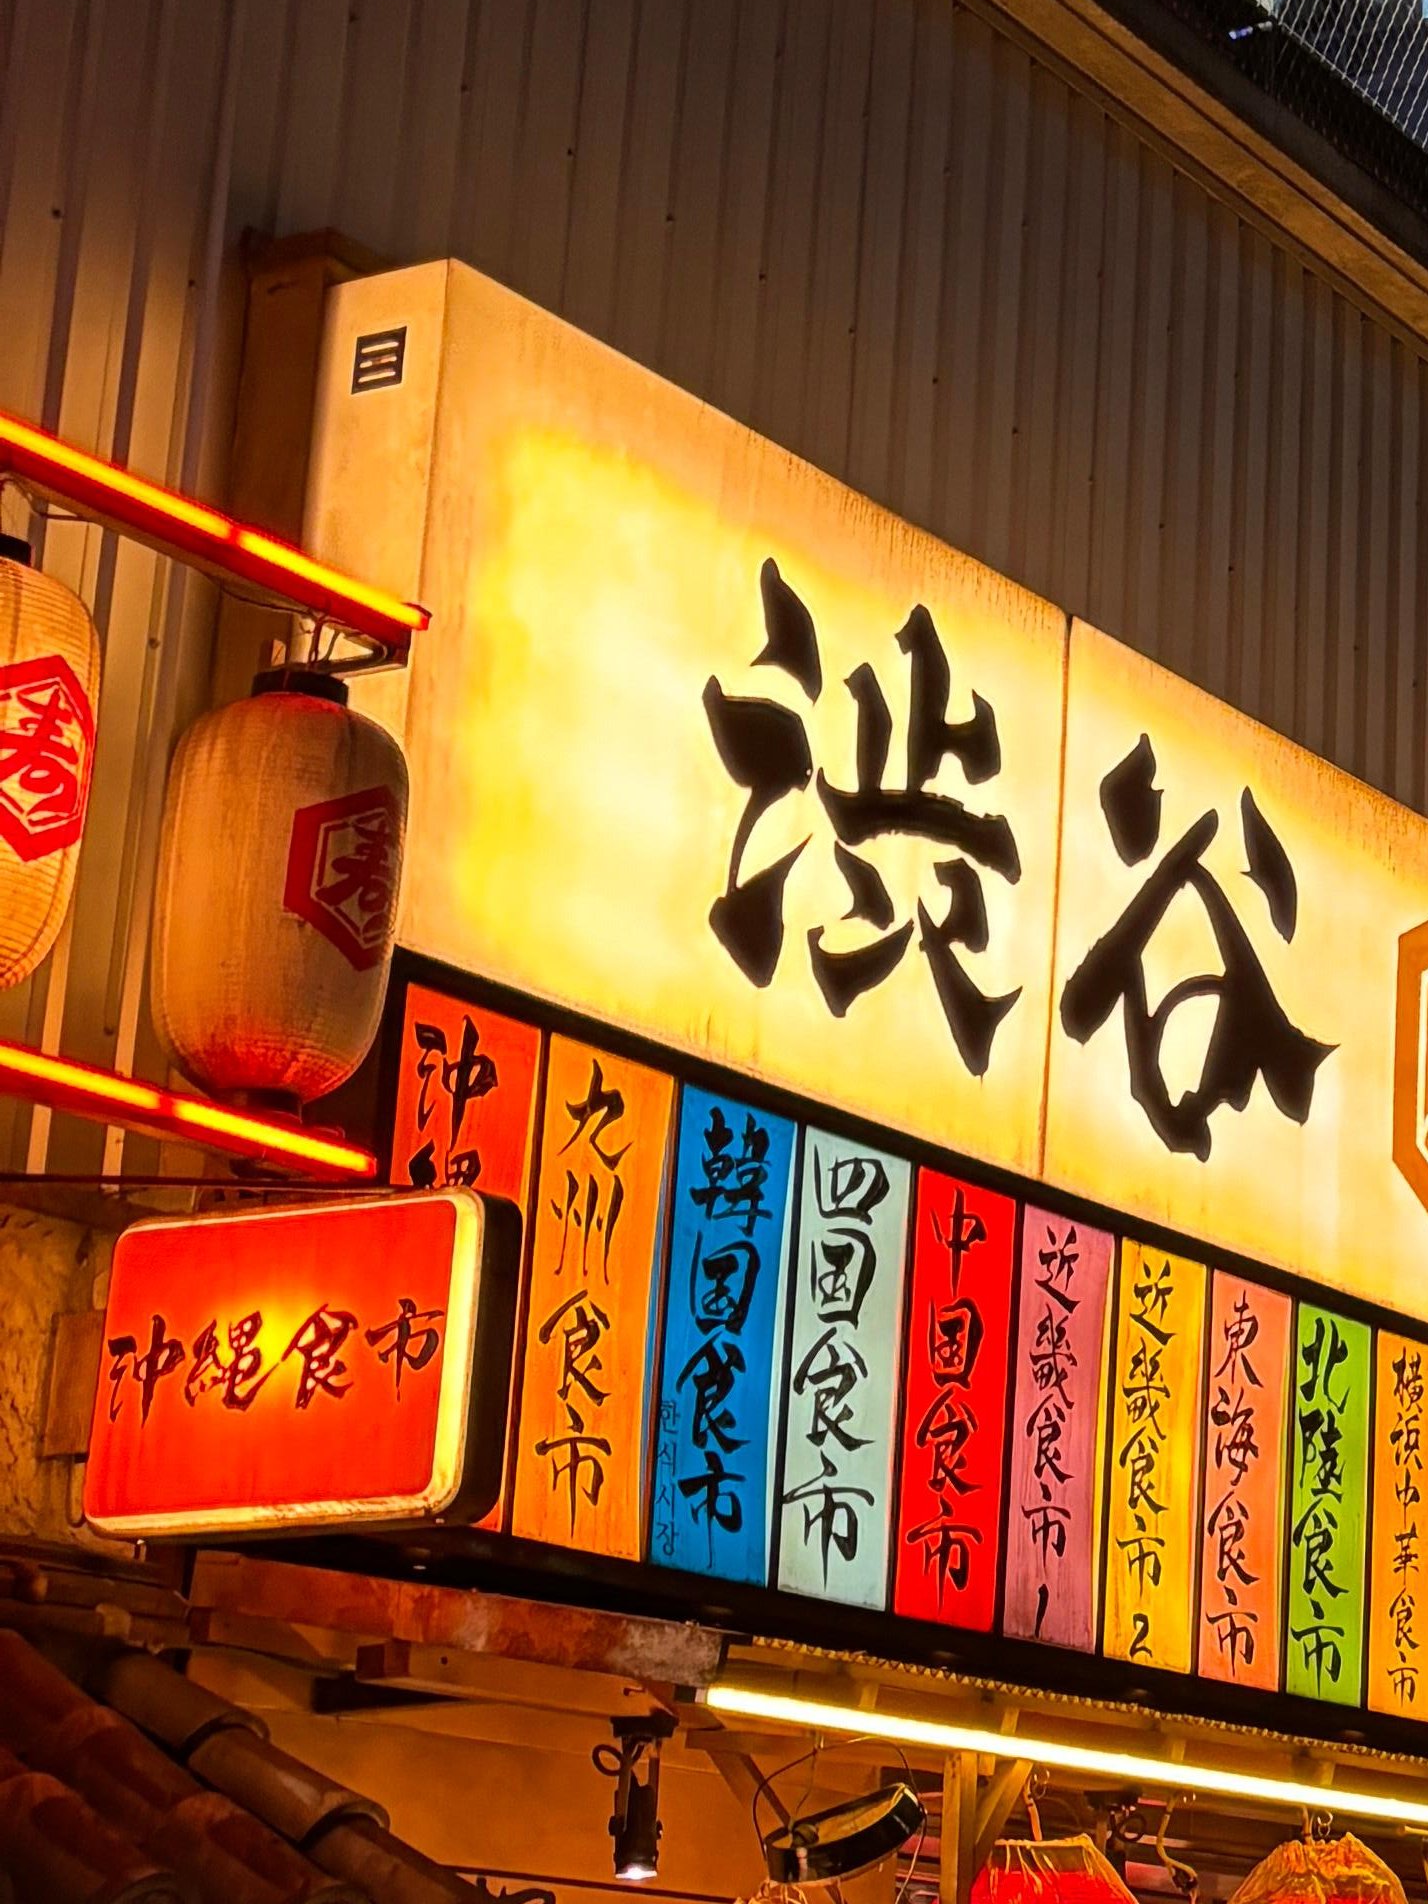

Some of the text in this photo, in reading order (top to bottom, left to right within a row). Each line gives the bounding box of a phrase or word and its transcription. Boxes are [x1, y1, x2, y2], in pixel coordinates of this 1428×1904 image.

[700, 557, 1340, 1163] 渋谷
[107, 1297, 445, 1430] 沖縄食市
[535, 1058, 634, 1538] 九州食市
[655, 1399, 681, 1557] 한식시장
[676, 1106, 773, 1568] 韓国食市
[782, 1142, 891, 1590] 四国食市
[906, 1187, 988, 1609] 中国食市
[1205, 1290, 1264, 1678] 東海食市
[1290, 1316, 1351, 1697] 北陸食市
[1386, 1346, 1425, 1708] 横浜中華食市
